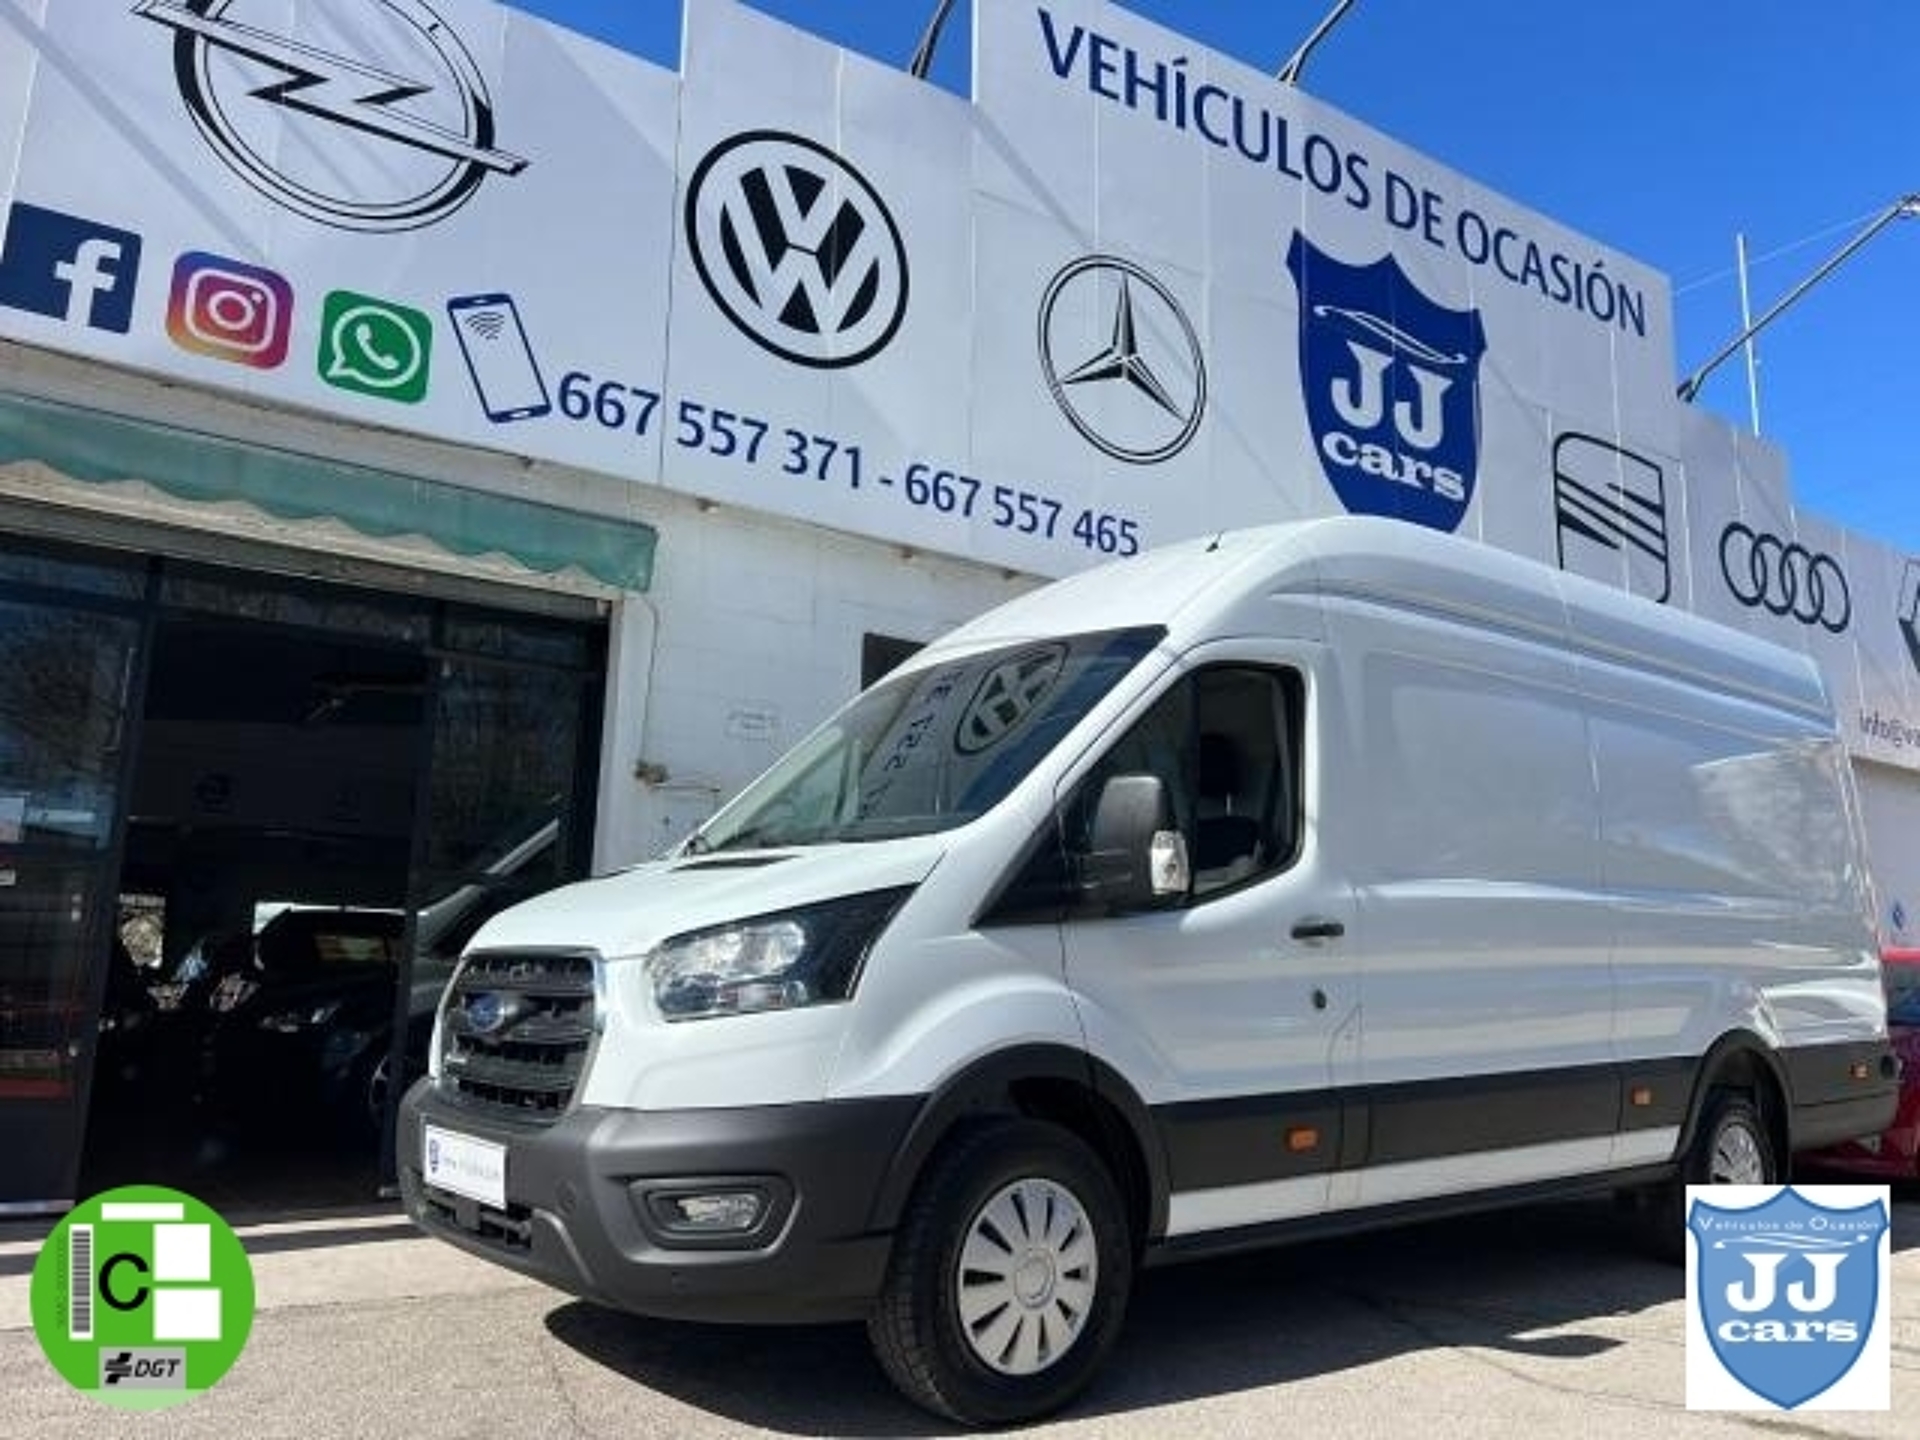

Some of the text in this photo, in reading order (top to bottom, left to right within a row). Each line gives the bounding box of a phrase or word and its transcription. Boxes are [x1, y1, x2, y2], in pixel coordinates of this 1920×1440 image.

[1037, 8, 1646, 337] VEHÍCULOS DE OCASIÓN
[557, 371, 660, 437] 667
[676, 401, 768, 463] 557
[782, 430, 862, 489] 371
[905, 464, 981, 517] 667
[993, 486, 1063, 540] 557
[1073, 509, 1140, 557] 465
[1323, 430, 1465, 501] cars
[1331, 340, 1456, 449] JJ
